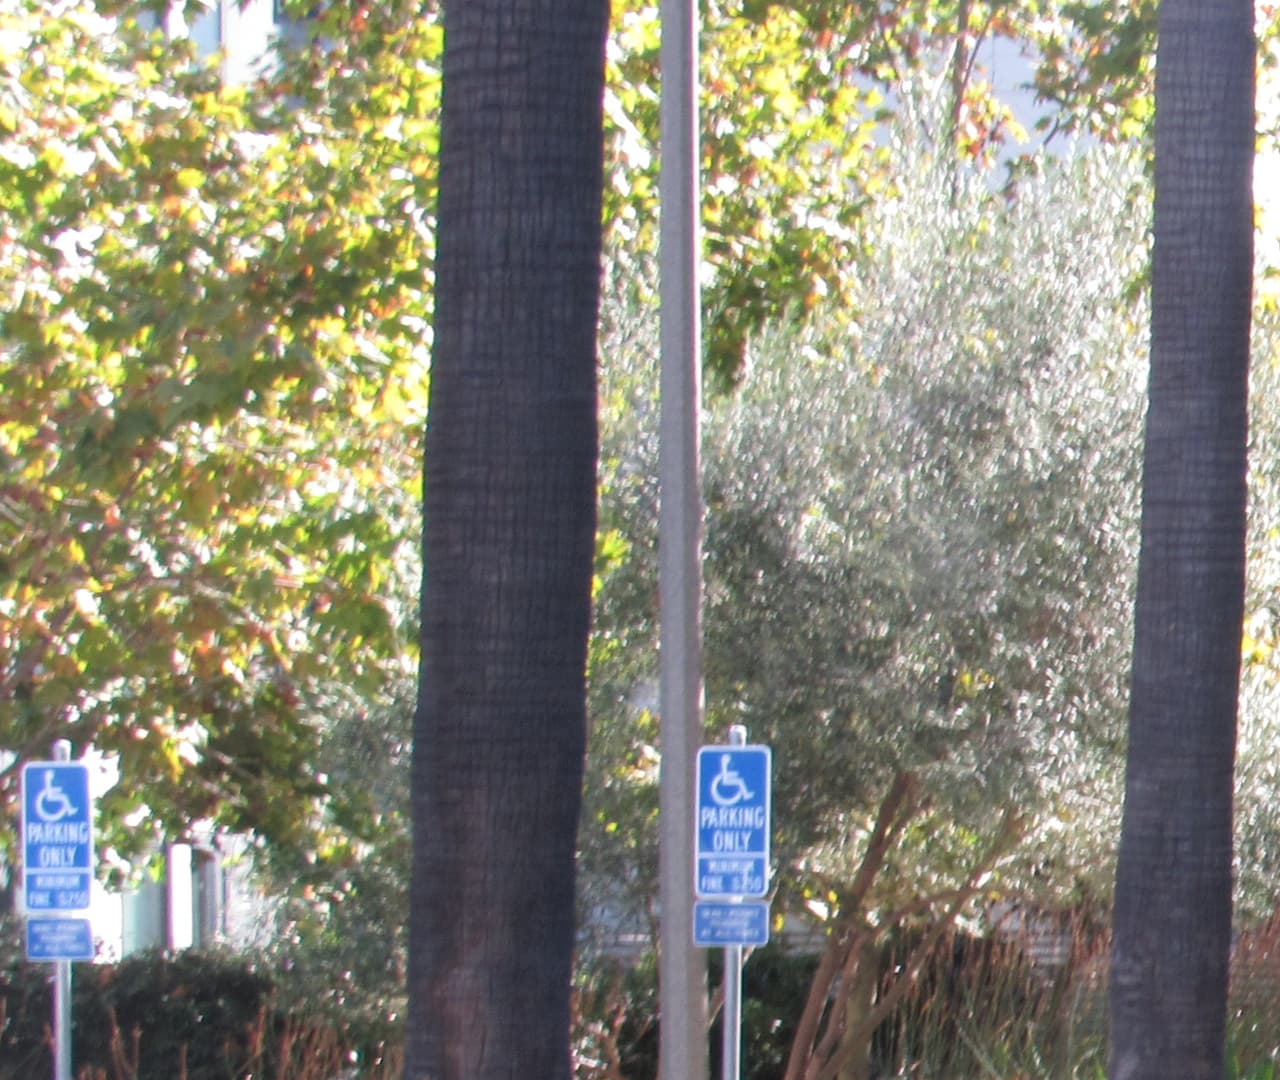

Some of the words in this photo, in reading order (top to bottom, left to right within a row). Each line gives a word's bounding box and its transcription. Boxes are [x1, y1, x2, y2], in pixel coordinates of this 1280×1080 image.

[701, 805, 764, 829] PARKING
[28, 821, 88, 845] PARKING
[713, 829, 752, 851] ONLY
[41, 845, 76, 867] ONLY
